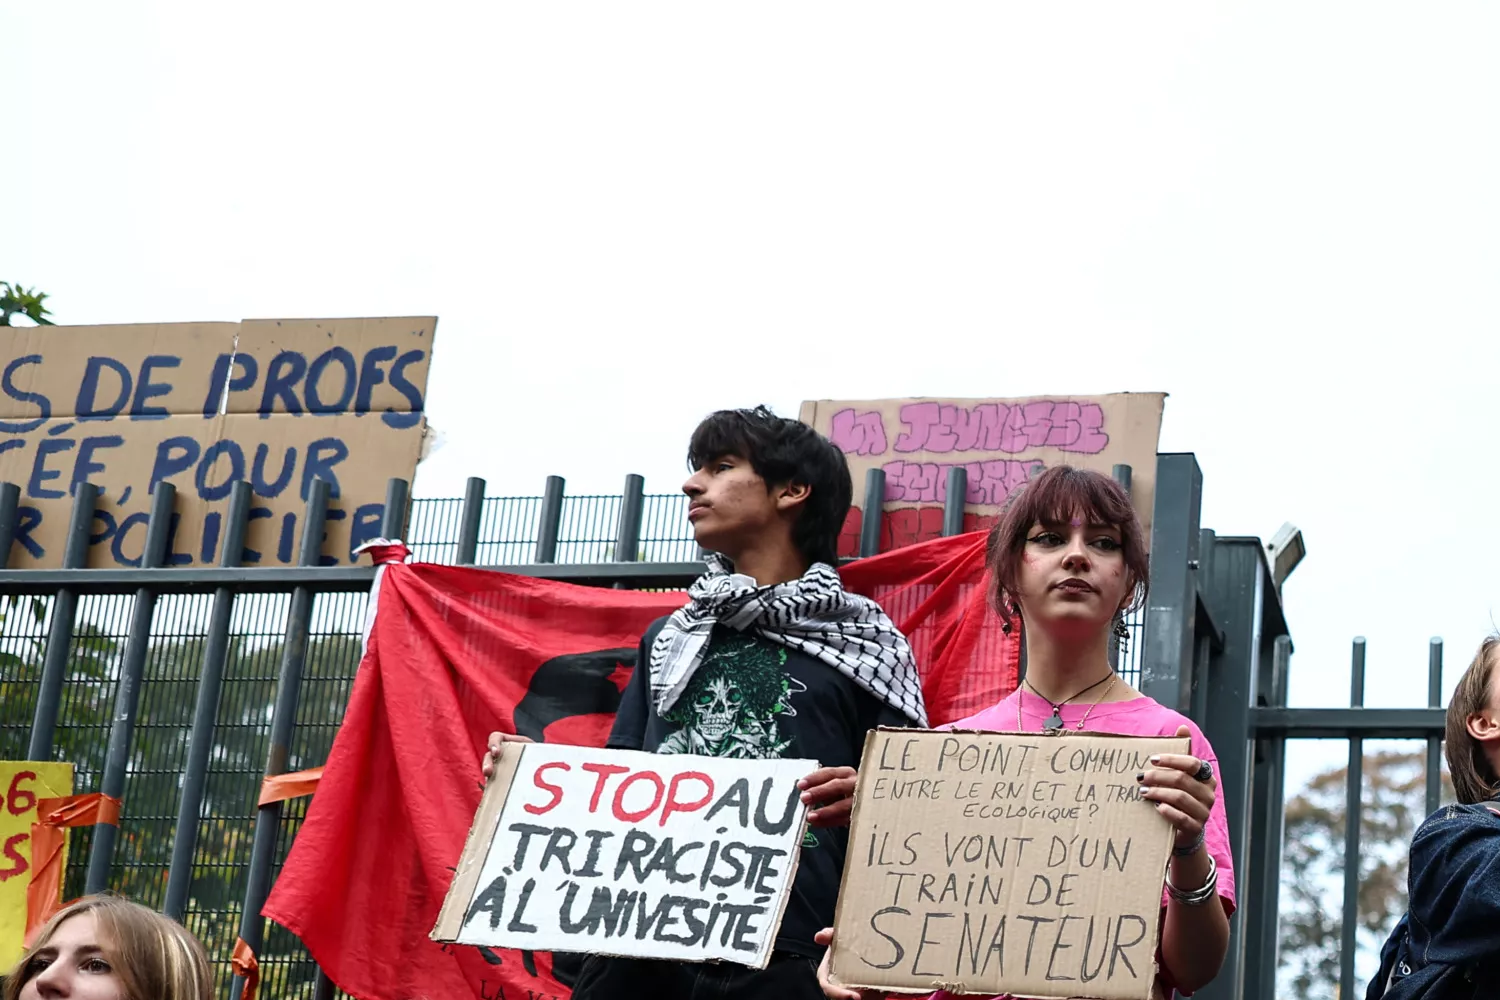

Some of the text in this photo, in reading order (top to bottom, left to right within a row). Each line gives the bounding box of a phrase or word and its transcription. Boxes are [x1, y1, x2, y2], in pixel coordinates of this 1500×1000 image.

[75, 355, 183, 421] DE
[202, 345, 427, 429] PROFS
[893, 401, 1110, 455] JEUNESSE
[148, 436, 349, 501] POUR
[878, 738, 919, 772] LE
[1050, 744, 1150, 775] COMMUN
[0, 770, 38, 816] 6
[523, 762, 807, 836] STOP AU
[872, 778, 941, 800] ENTRE
[955, 781, 980, 799] LE
[990, 780, 1024, 800] RN
[1032, 780, 1067, 801] ET
[1074, 783, 1097, 803] LA
[508, 823, 614, 878] TRI
[945, 832, 1034, 869] VONT
[1047, 834, 1132, 872] D'UN
[1026, 874, 1080, 907] DE
[859, 906, 1149, 984] SENATEUR
